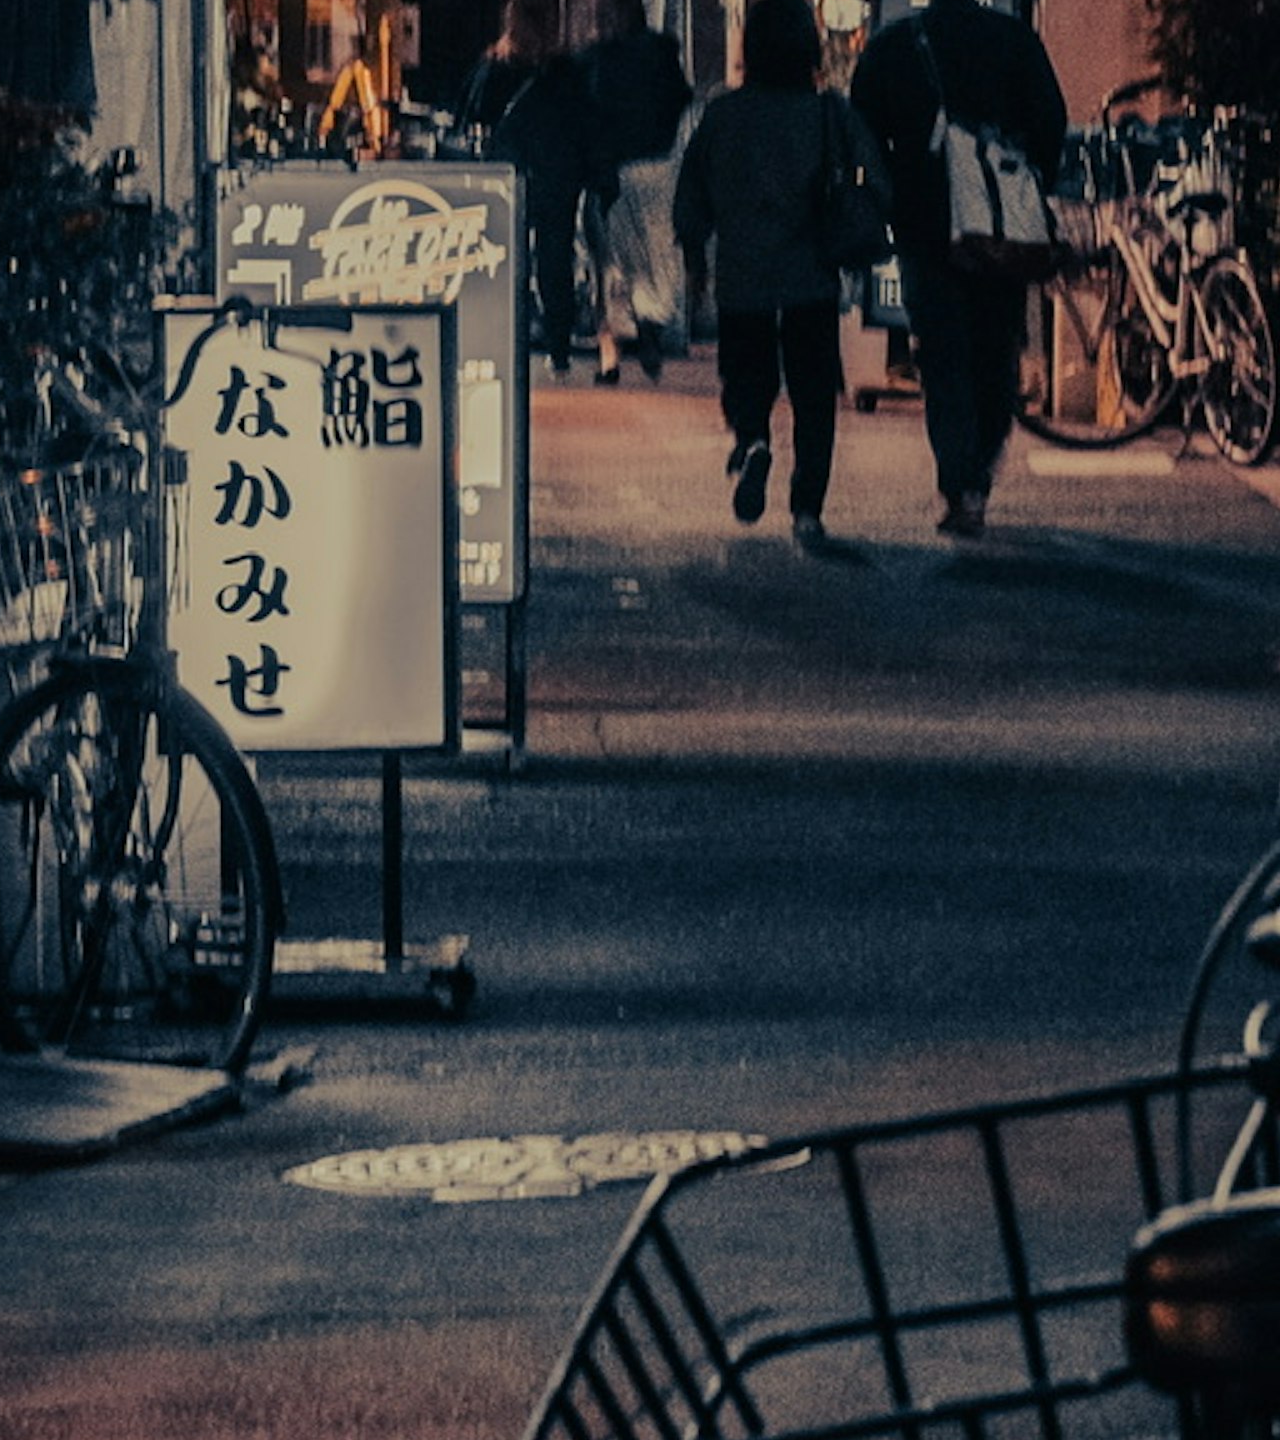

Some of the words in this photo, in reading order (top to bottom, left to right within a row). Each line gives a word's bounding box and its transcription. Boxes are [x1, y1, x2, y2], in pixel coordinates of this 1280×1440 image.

[320, 346, 424, 450] 鮨
[215, 366, 293, 719] なかみせ
